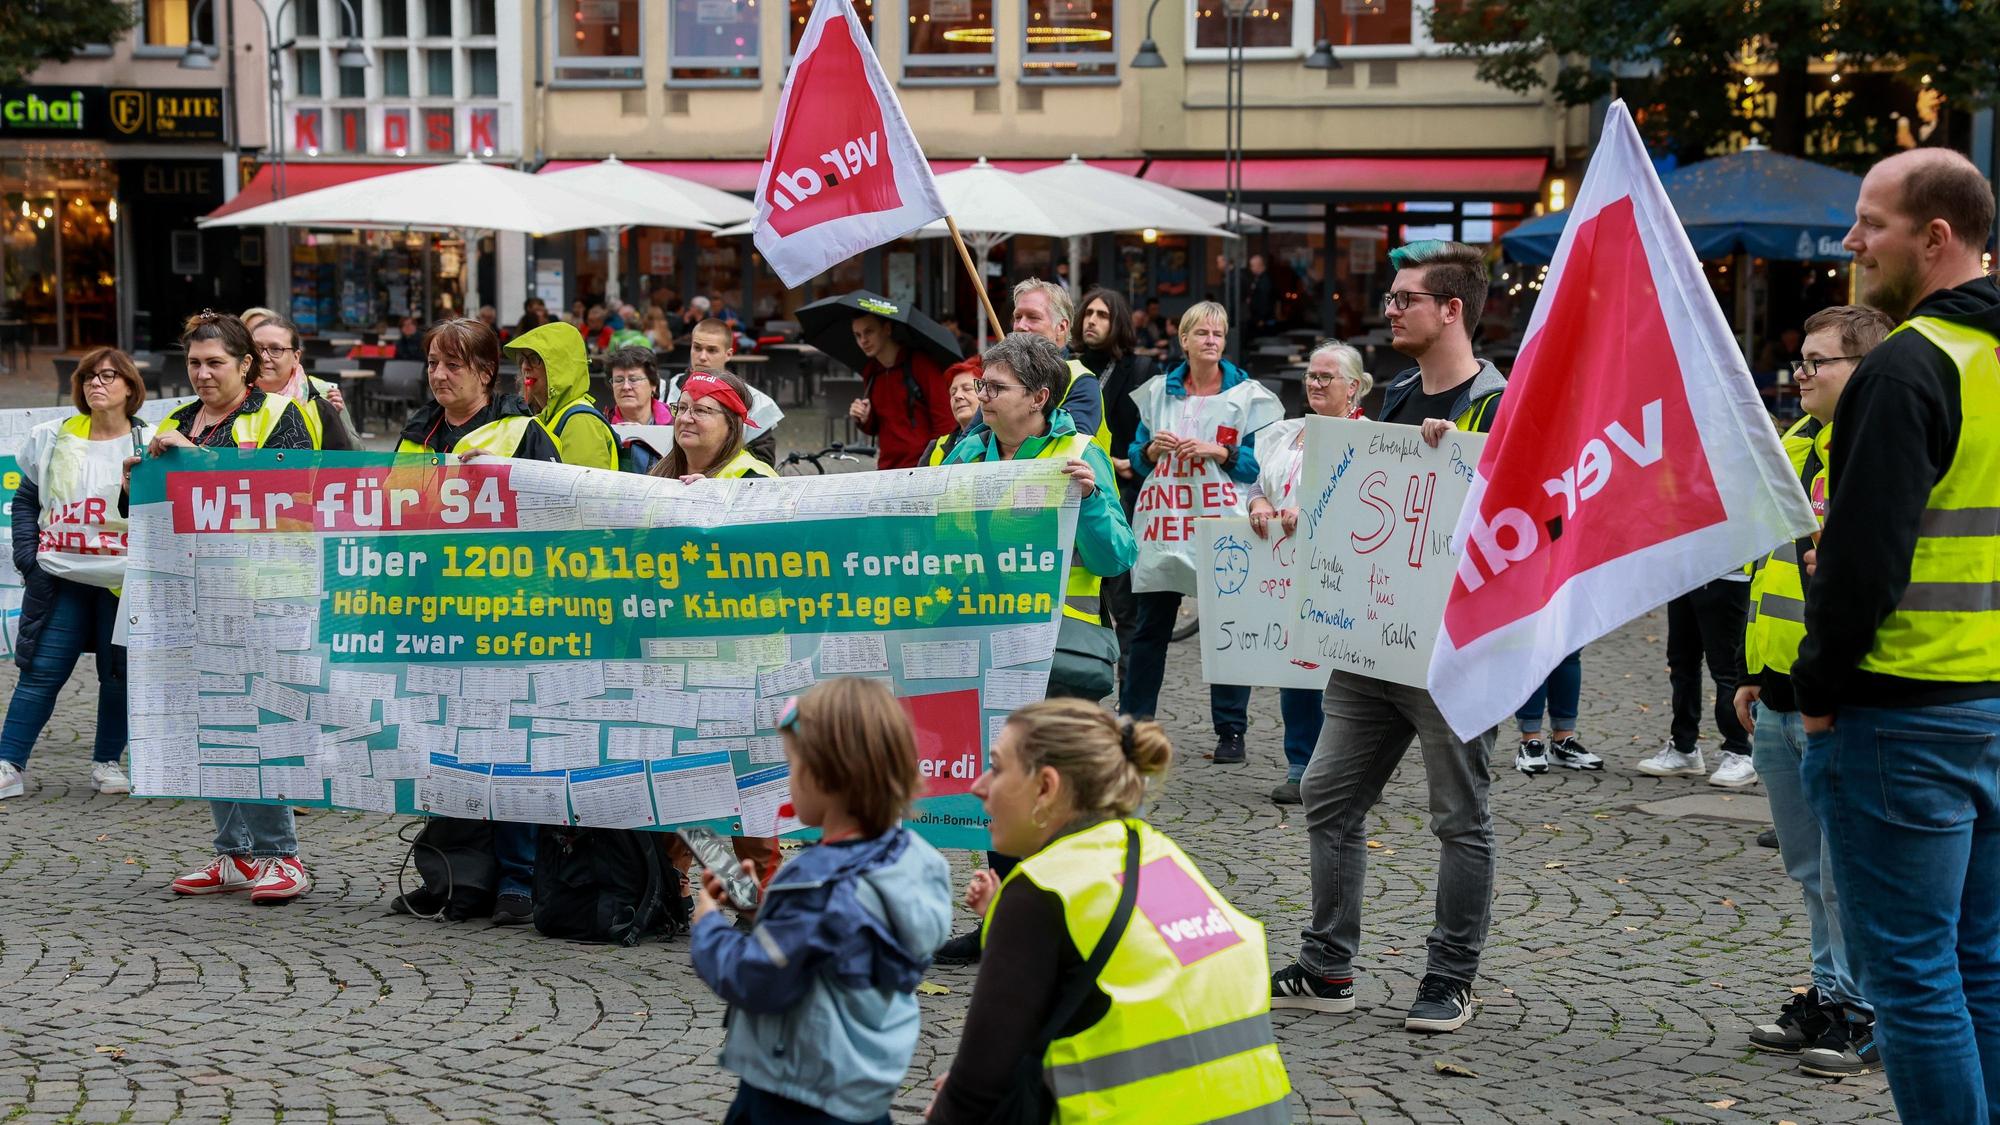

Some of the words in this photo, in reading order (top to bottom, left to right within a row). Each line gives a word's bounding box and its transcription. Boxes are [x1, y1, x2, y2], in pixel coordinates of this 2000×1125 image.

[0, 91, 83, 129] chai
[157, 97, 218, 117] ELITE
[295, 113, 495, 150] KIOSK
[1818, 235, 1853, 256] Ga
[692, 375, 717, 384] ver.di
[191, 478, 294, 530] Wir
[316, 477, 420, 528] für
[440, 476, 504, 524] S4
[1136, 484, 1193, 513] SIND
[1202, 482, 1238, 508] ES
[1143, 514, 1222, 542] WER
[1350, 470, 1437, 570] S4
[337, 537, 427, 577] Über
[442, 546, 534, 578] 1200
[842, 550, 985, 577] fordern
[997, 543, 1055, 573] die
[1367, 562, 1390, 595] für
[333, 588, 613, 625] Höhergruppierung
[622, 594, 674, 618] der
[1300, 598, 1356, 630] Chorweiler
[1367, 604, 1379, 621] in
[332, 630, 384, 654] und
[395, 633, 465, 655] zwar
[476, 631, 592, 657] sofort!
[1216, 620, 1235, 651] 5
[1236, 631, 1260, 651] vor
[1381, 622, 1417, 650] Kalk
[917, 753, 976, 779] er.di
[1160, 907, 1233, 943] ver.di
